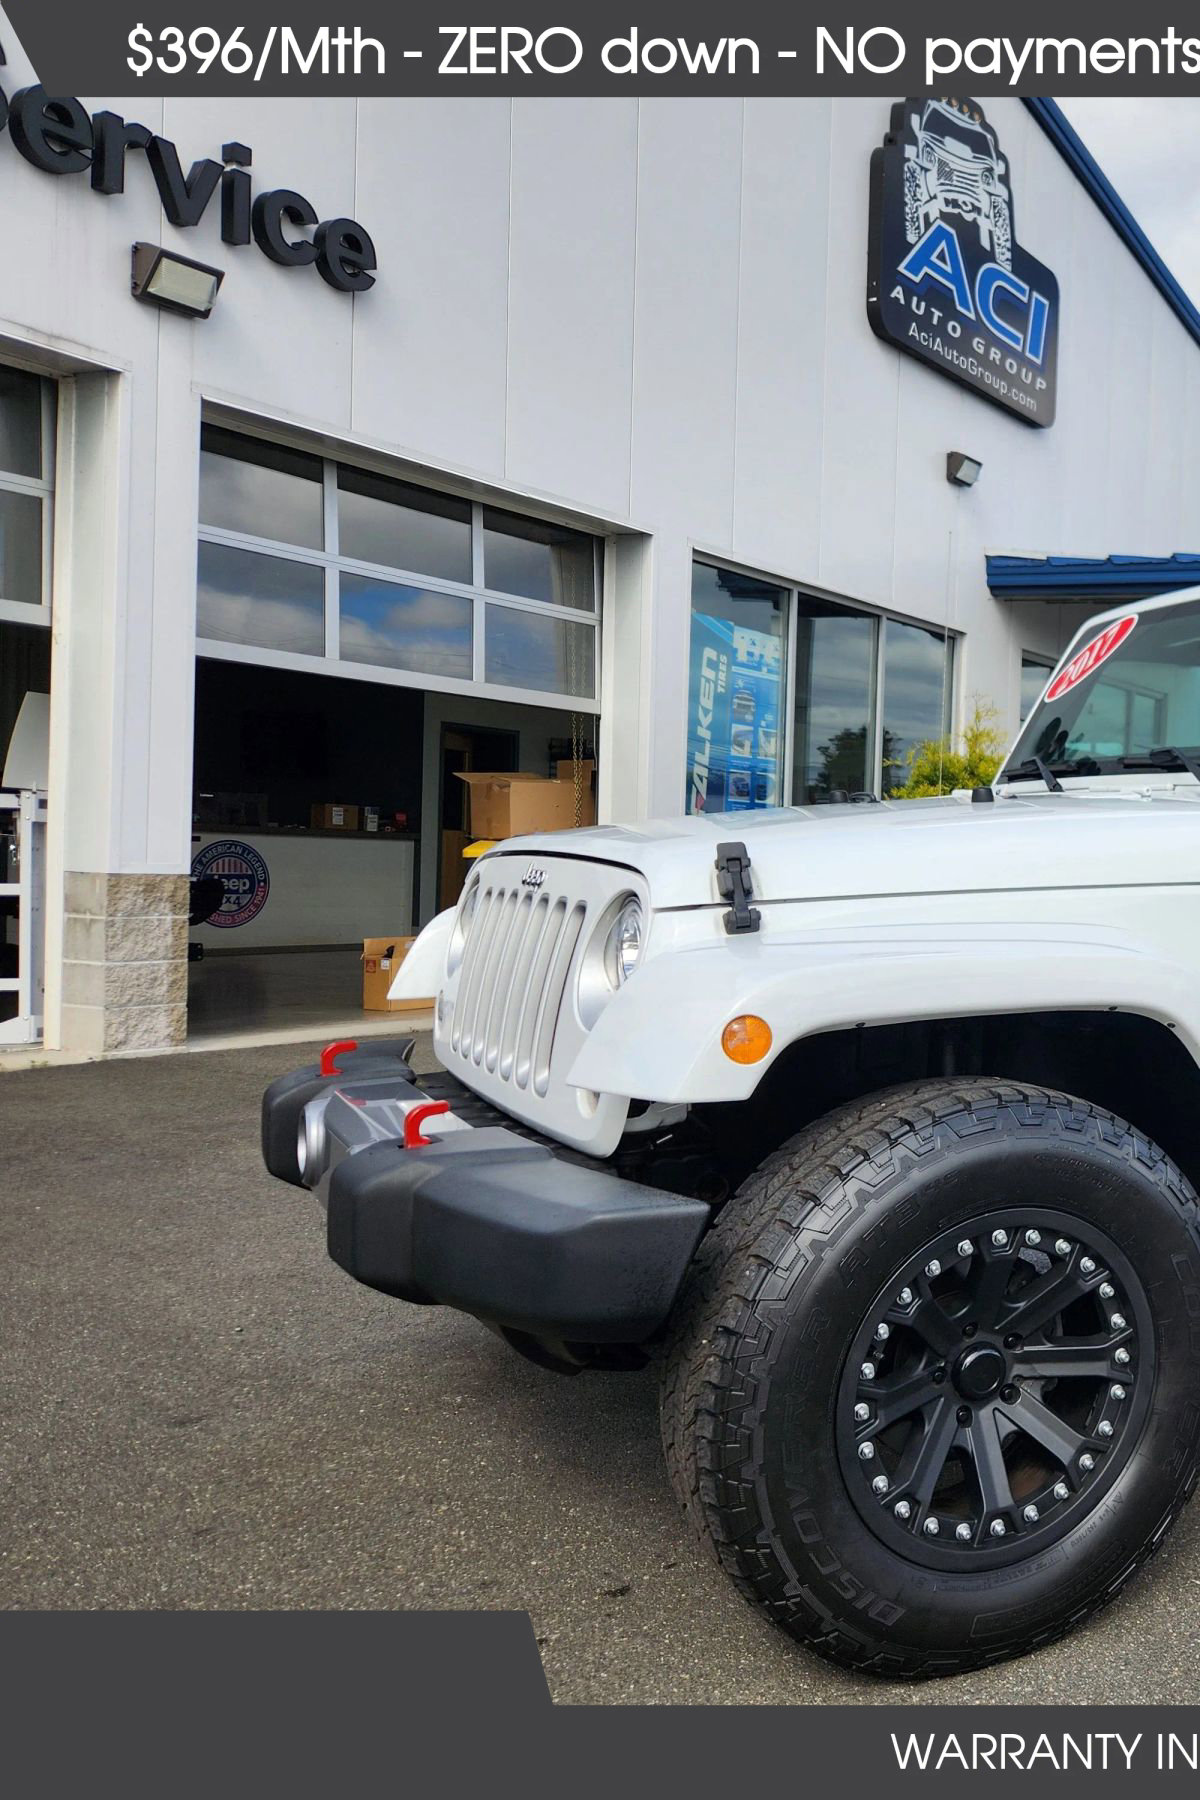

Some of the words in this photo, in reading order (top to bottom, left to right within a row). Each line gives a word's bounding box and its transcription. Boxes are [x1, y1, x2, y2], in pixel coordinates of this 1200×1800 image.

[0, 43, 377, 292] ervice
[896, 219, 1049, 366] ACI
[890, 286, 962, 339] AUTO
[972, 337, 1047, 391] GROUP
[908, 322, 1037, 411] AciAutoGroup.com
[717, 654, 728, 694] TIRES
[1055, 622, 1121, 697] 2017
[203, 844, 242, 861] AMERICAN
[244, 848, 265, 880] LEGEND
[214, 875, 250, 893] eep
[234, 904, 257, 922] SINCE
